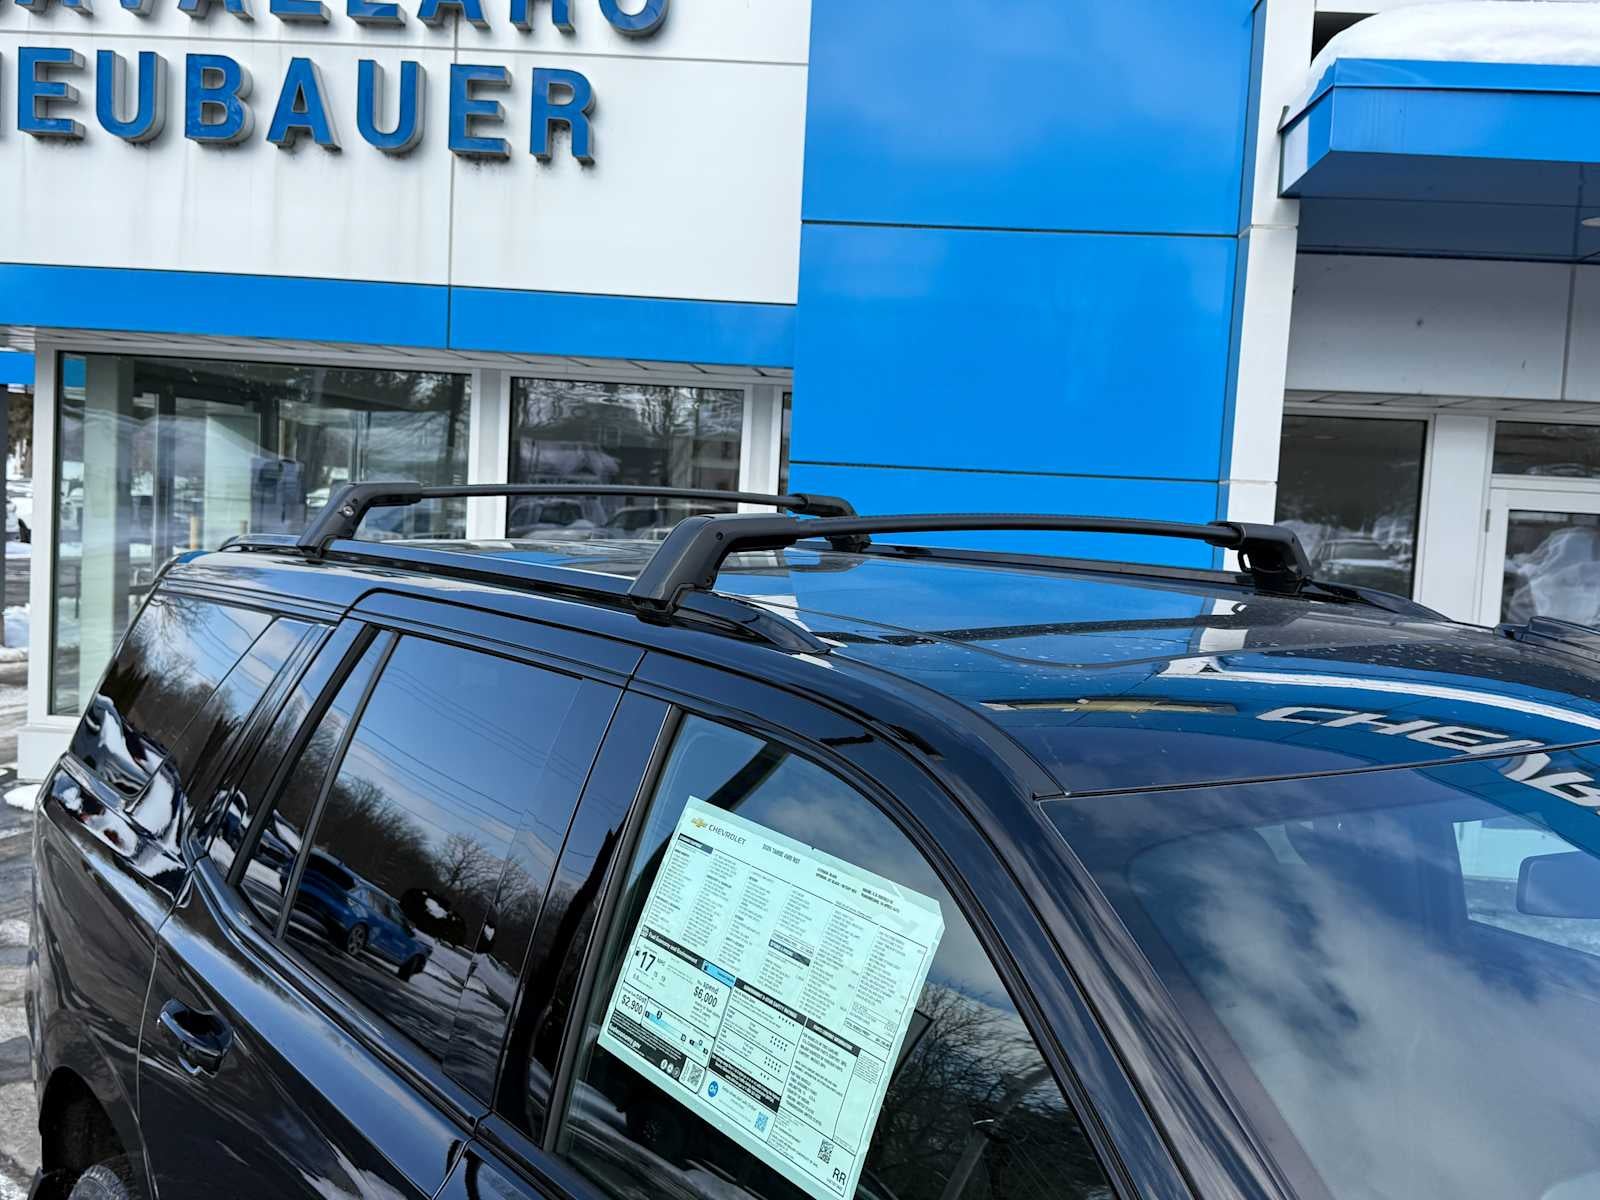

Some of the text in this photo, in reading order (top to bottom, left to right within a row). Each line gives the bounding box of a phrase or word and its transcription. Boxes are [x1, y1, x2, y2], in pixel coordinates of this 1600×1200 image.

[0, 46, 596, 166] EUBAUER
[708, 824, 747, 846] CHEVROLET
[640, 951, 656, 972] 17
[622, 994, 643, 1015] $2,900
[693, 986, 718, 1008] $6,000
[832, 1167, 847, 1186] RR
